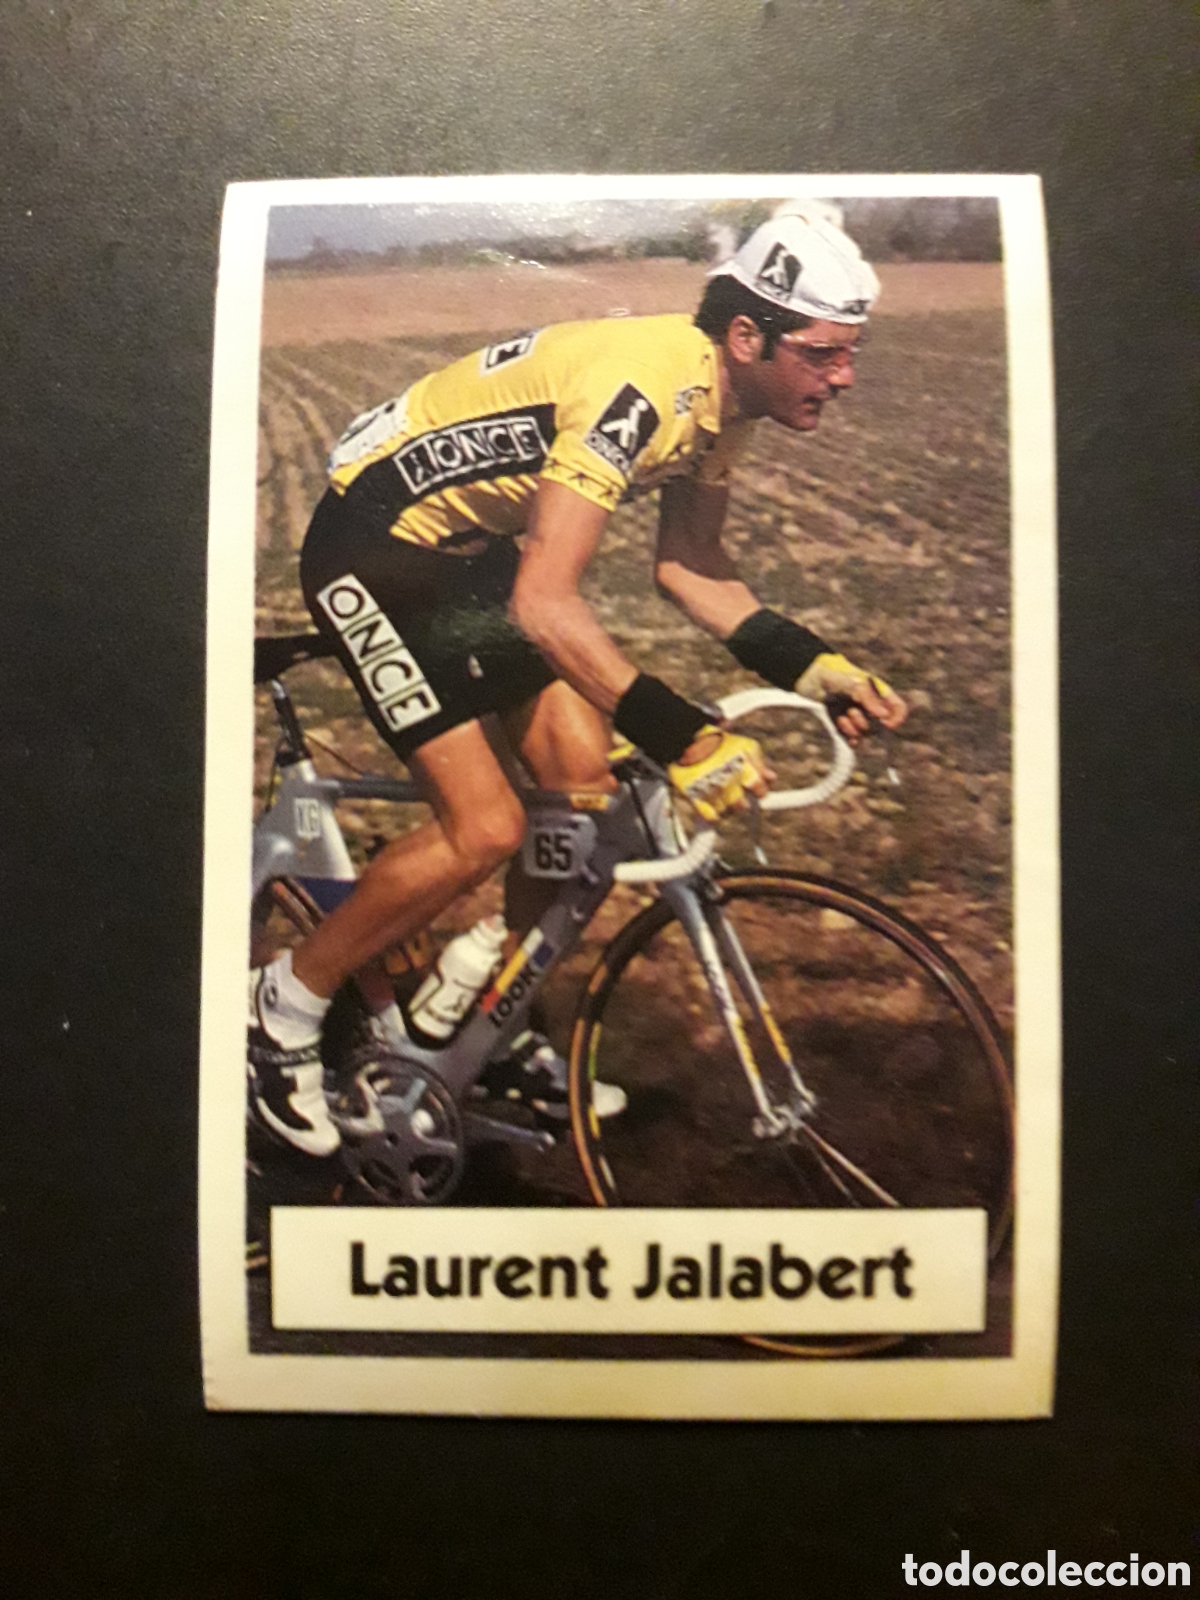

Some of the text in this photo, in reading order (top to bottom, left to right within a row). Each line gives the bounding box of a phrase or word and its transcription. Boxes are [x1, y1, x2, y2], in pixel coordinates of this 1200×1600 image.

[432, 422, 536, 469] ONCE
[328, 585, 432, 725] ONCE
[534, 831, 573, 872] 65
[349, 1241, 915, 1301] Laurent Jalabert
